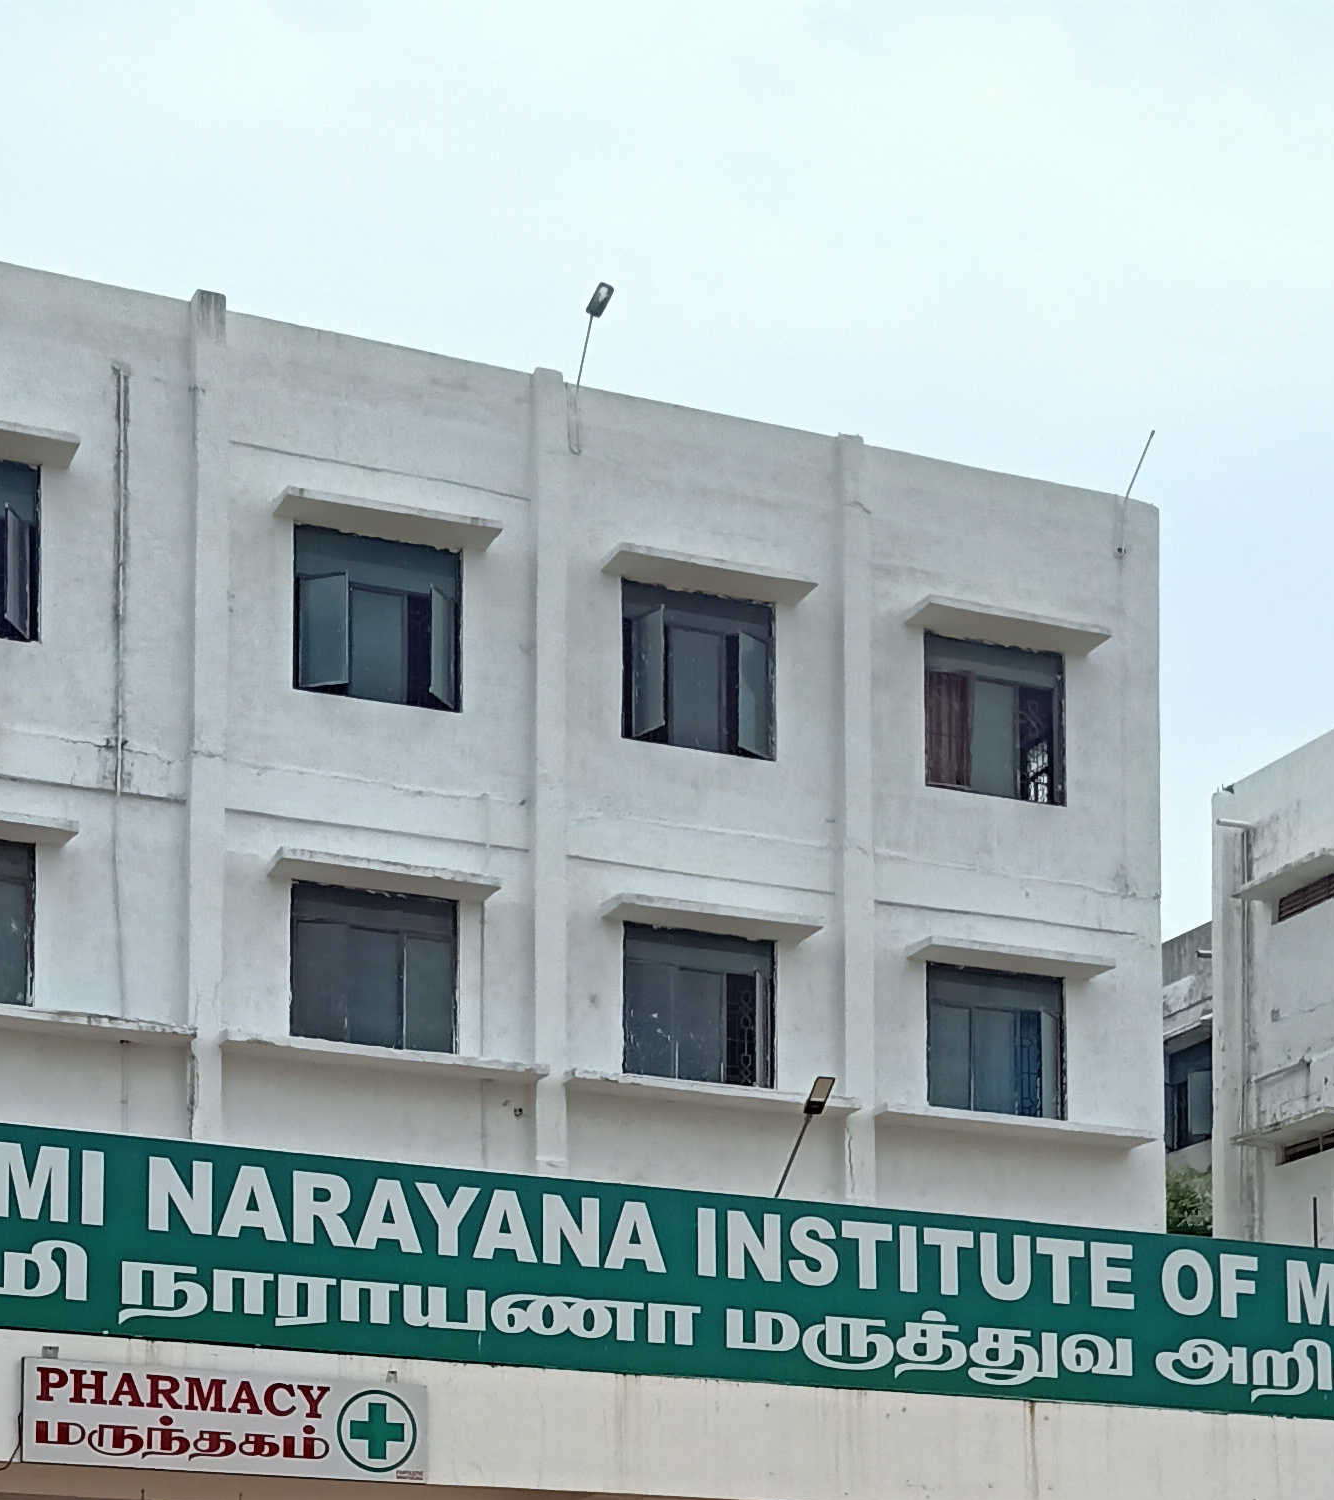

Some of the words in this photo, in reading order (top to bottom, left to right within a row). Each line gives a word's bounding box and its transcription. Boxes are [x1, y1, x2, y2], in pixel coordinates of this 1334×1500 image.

[149, 1157, 667, 1273] NARAYANA
[698, 1208, 1135, 1310] INSTITUTE
[1162, 1250, 1258, 1319] OF
[118, 1261, 701, 1346] நாராயணா
[726, 1309, 1133, 1386] மருத்துவ
[36, 1366, 331, 1419] PHARMACY
[35, 1415, 330, 1461] மருந்தகம்
